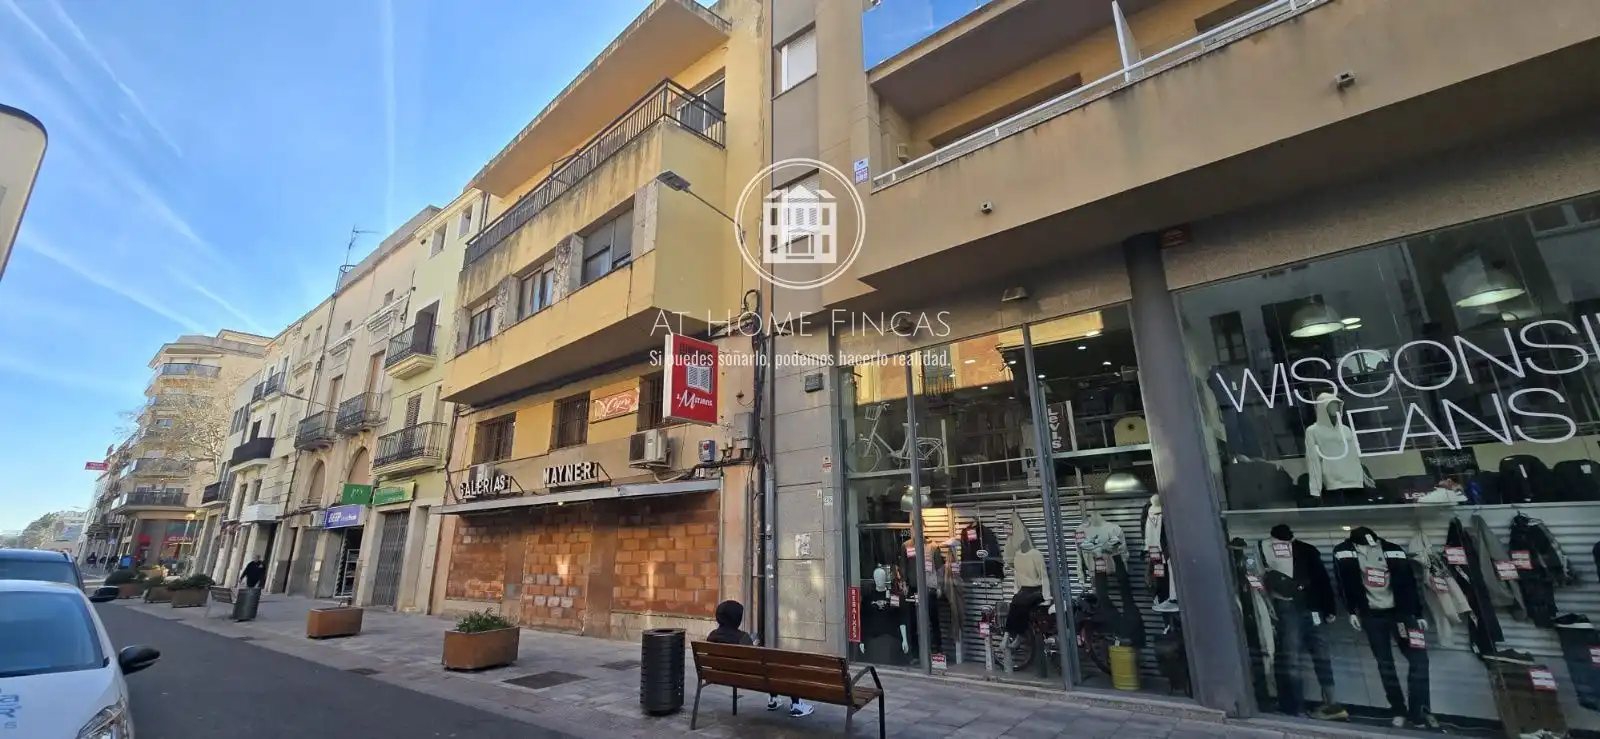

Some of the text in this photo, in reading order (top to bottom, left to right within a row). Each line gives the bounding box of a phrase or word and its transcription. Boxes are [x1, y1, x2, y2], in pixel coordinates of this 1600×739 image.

[1215, 311, 1600, 413] WISCONSI
[1315, 387, 1577, 461] JEANS
[459, 474, 507, 498] GALERIAS
[542, 461, 593, 485] MAYNER
